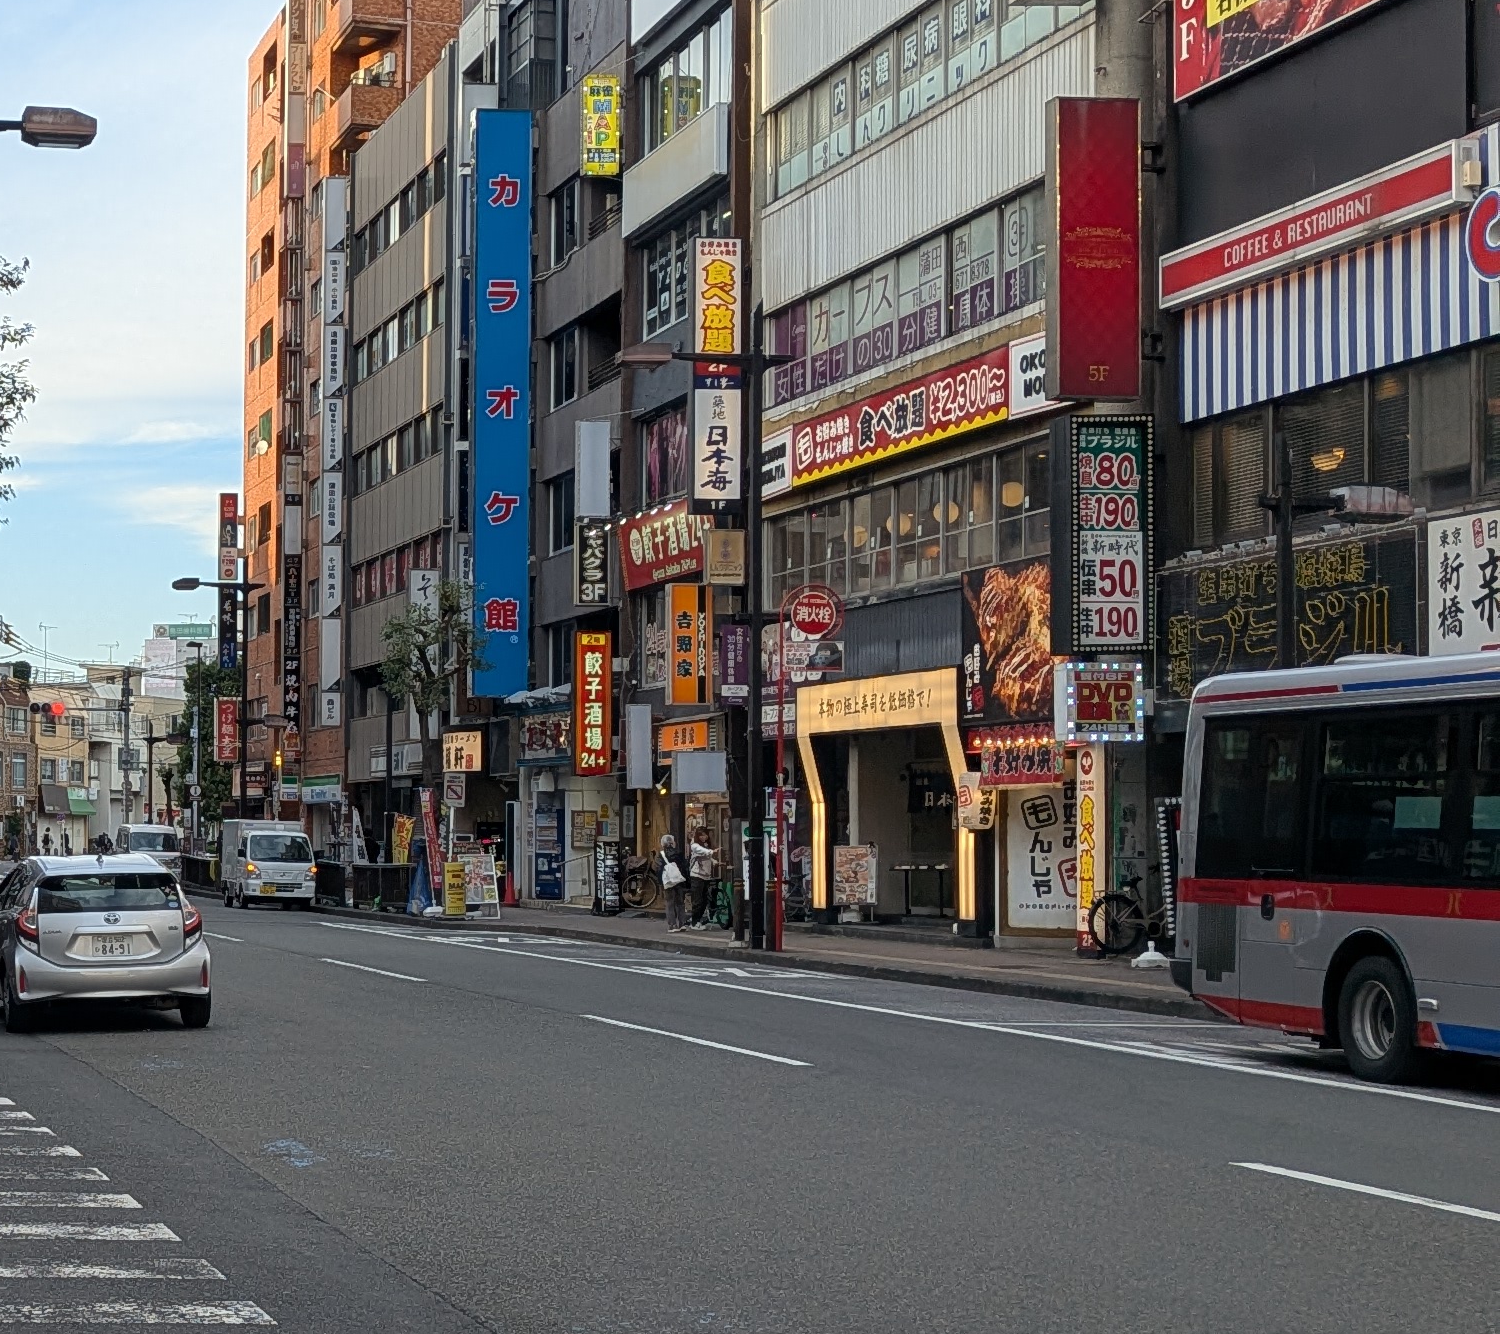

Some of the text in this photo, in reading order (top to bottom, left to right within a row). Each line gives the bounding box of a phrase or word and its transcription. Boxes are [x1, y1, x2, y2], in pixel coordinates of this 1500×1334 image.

[833, 62, 872, 117] 内科
[875, 15, 940, 98] 糖尿病
[834, 36, 990, 159] しんクリニック
[1223, 193, 1373, 268] COFFEE & RESTAURANT
[701, 258, 737, 354] 食べ放題
[813, 273, 894, 347] カーブス
[1088, 365, 1110, 382] 5F
[485, 175, 522, 635] カラオケ館
[857, 386, 926, 450] 食べ放題
[815, 414, 850, 442] お好み焼き
[1087, 435, 1139, 449] ブラジル
[700, 425, 734, 492] 日本海
[815, 433, 854, 463] もんじゃ焼き
[1080, 453, 1093, 486] 焼鳥
[1080, 495, 1093, 526] 生中
[1091, 539, 1140, 556] 新時代
[1439, 526, 1463, 549] 東京
[581, 584, 606, 602] 3F
[1081, 559, 1097, 597] 伝串
[1438, 552, 1464, 640] 新橋
[795, 605, 832, 623] 消火栓
[1081, 607, 1094, 638] 生中
[676, 611, 693, 678] 吉野家
[584, 651, 603, 750] 餃子酒場
[1076, 683, 1134, 701] DVD
[101, 943, 131, 956] 84-91
